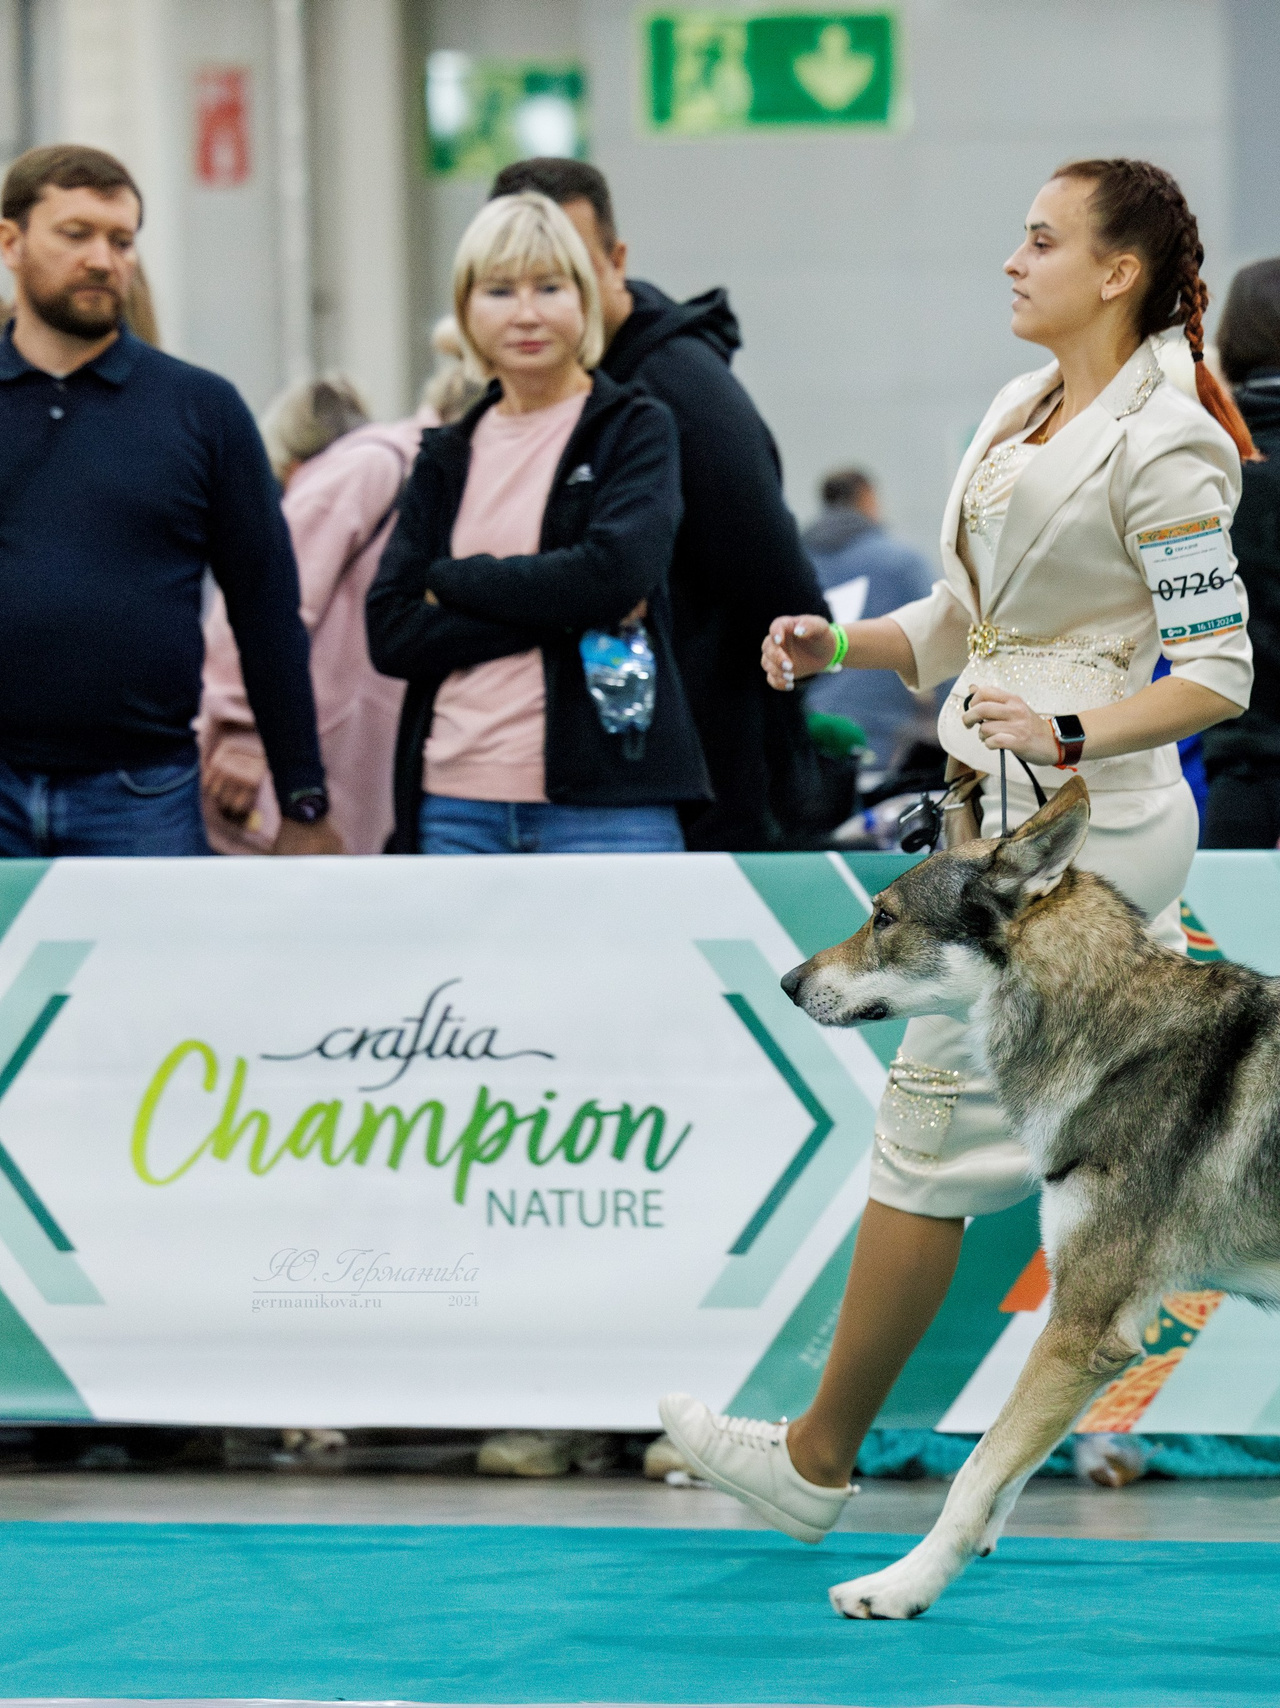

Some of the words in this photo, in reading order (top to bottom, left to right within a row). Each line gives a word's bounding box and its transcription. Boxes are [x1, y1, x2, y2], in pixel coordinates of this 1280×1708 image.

[1158, 567, 1225, 601] 0726
[258, 976, 557, 1094] craftia
[130, 1038, 693, 1206] Champion
[487, 1188, 666, 1229] NATURE
